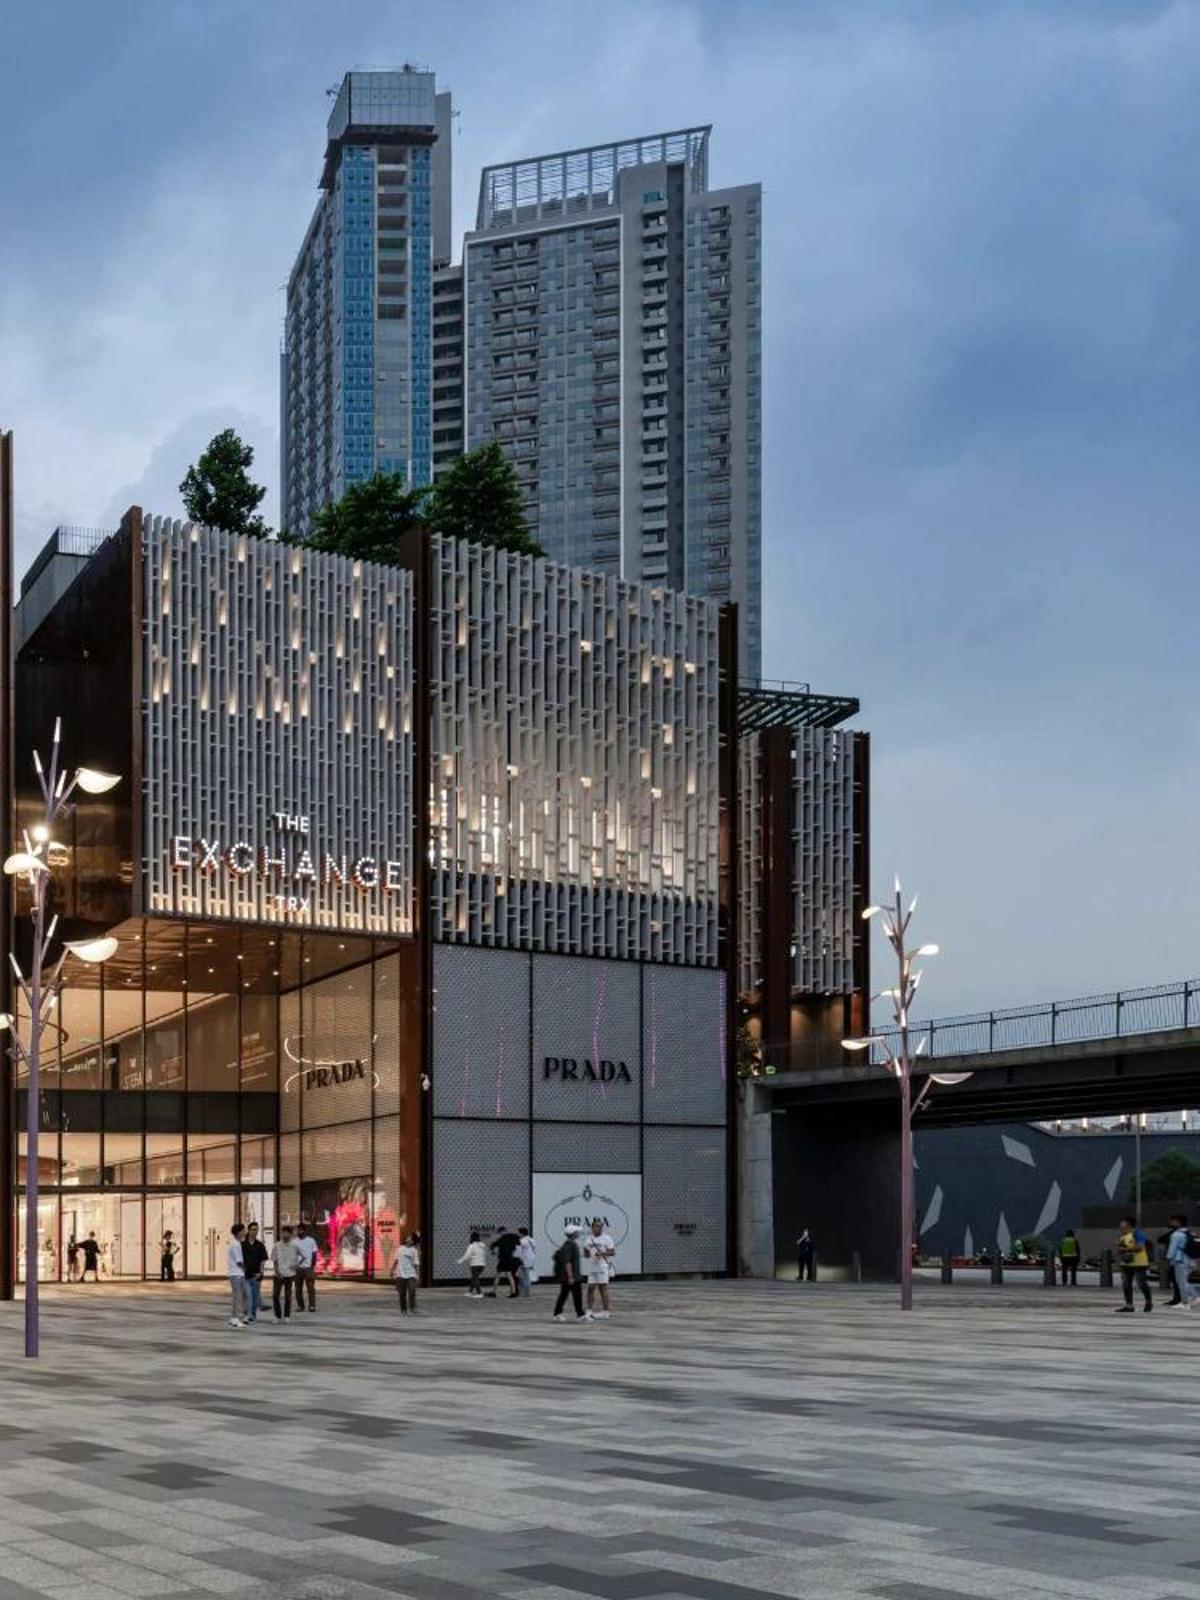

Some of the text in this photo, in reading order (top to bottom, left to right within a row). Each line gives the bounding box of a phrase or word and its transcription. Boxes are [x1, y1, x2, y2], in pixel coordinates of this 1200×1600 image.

[275, 812, 310, 833] THE
[173, 835, 401, 889] EXCHANGE
[274, 895, 310, 912] TRX
[306, 1060, 364, 1090] PRADA
[544, 1057, 632, 1082] PRADA
